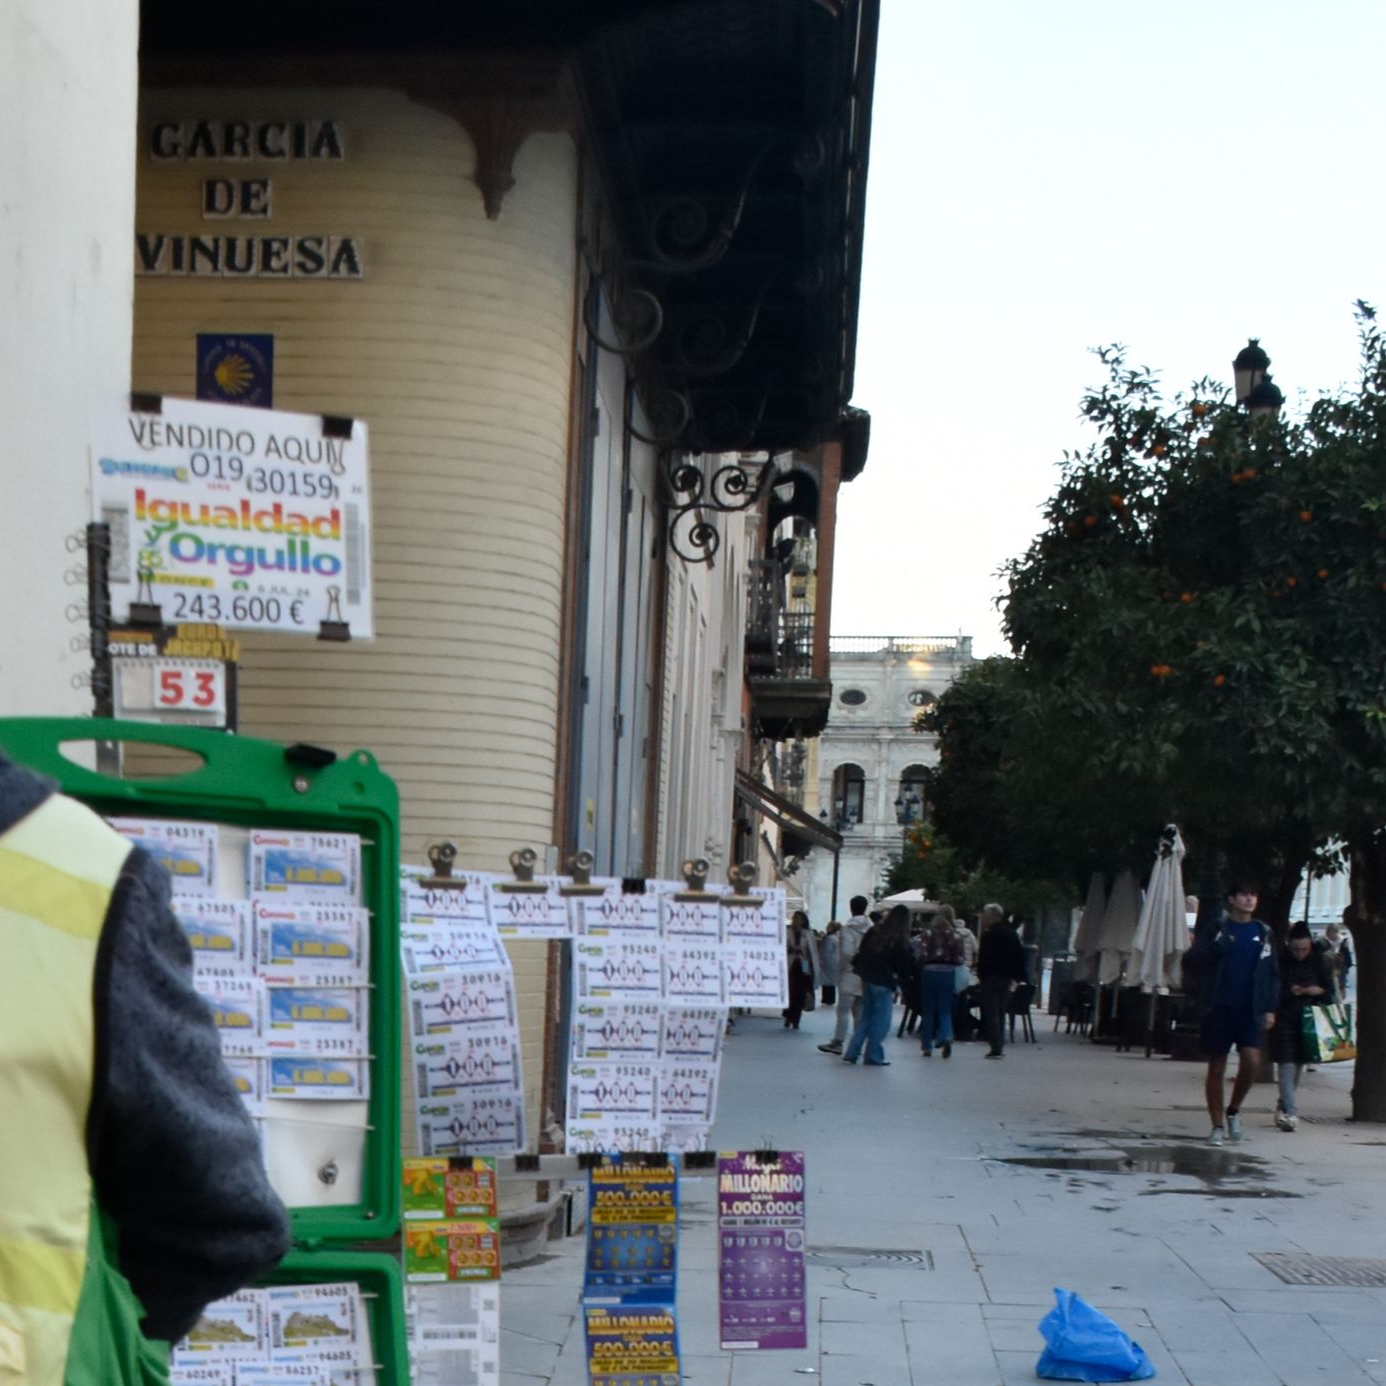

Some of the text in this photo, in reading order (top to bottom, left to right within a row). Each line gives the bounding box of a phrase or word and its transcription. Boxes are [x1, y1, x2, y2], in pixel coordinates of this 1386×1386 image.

[151, 121, 342, 160] GARCIA
[204, 179, 270, 215] DE
[136, 234, 360, 275] VINUESA
[129, 418, 255, 454] VENDIDO
[134, 487, 342, 541] Igualdad
[169, 531, 342, 577] Orgullo
[173, 593, 304, 625] 243.600 €
[720, 1173, 804, 1193] MILLONARIO
[719, 1201, 804, 1215] 1.000.000€
